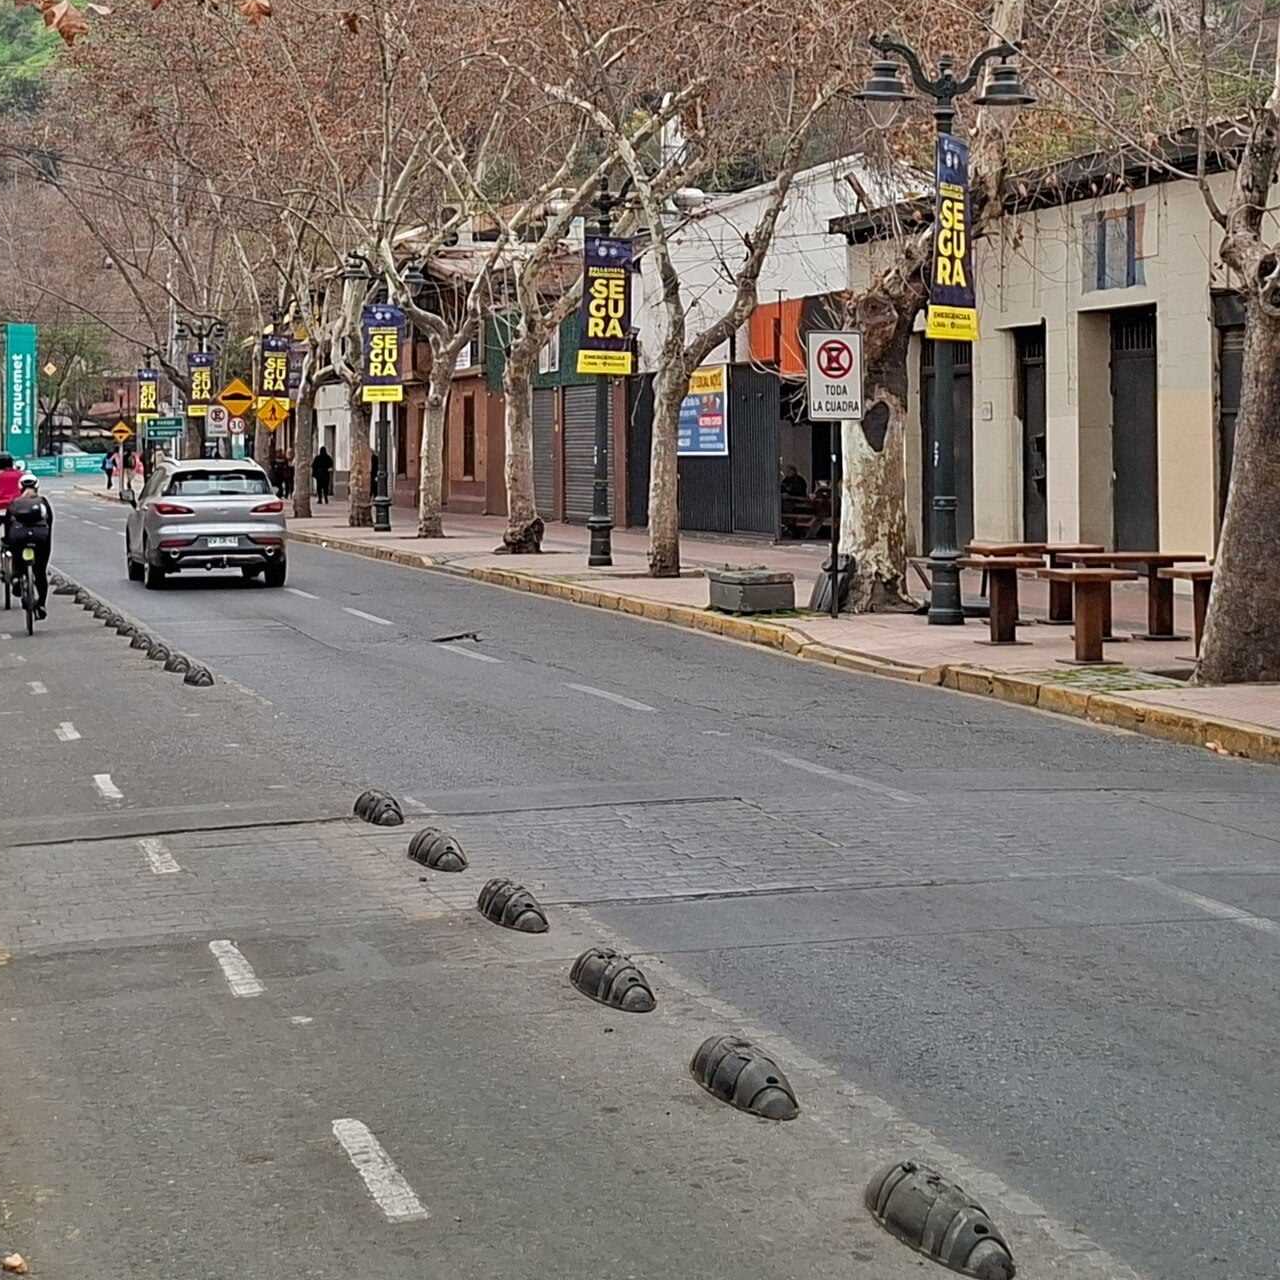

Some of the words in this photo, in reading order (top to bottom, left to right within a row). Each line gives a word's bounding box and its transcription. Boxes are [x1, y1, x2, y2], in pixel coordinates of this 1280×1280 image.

[11, 353, 25, 434] Parquemet
[825, 384, 848, 396] TODA
[813, 400, 824, 412] LA
[825, 400, 860, 412] CUADRA
[230, 420, 244, 430] 30
